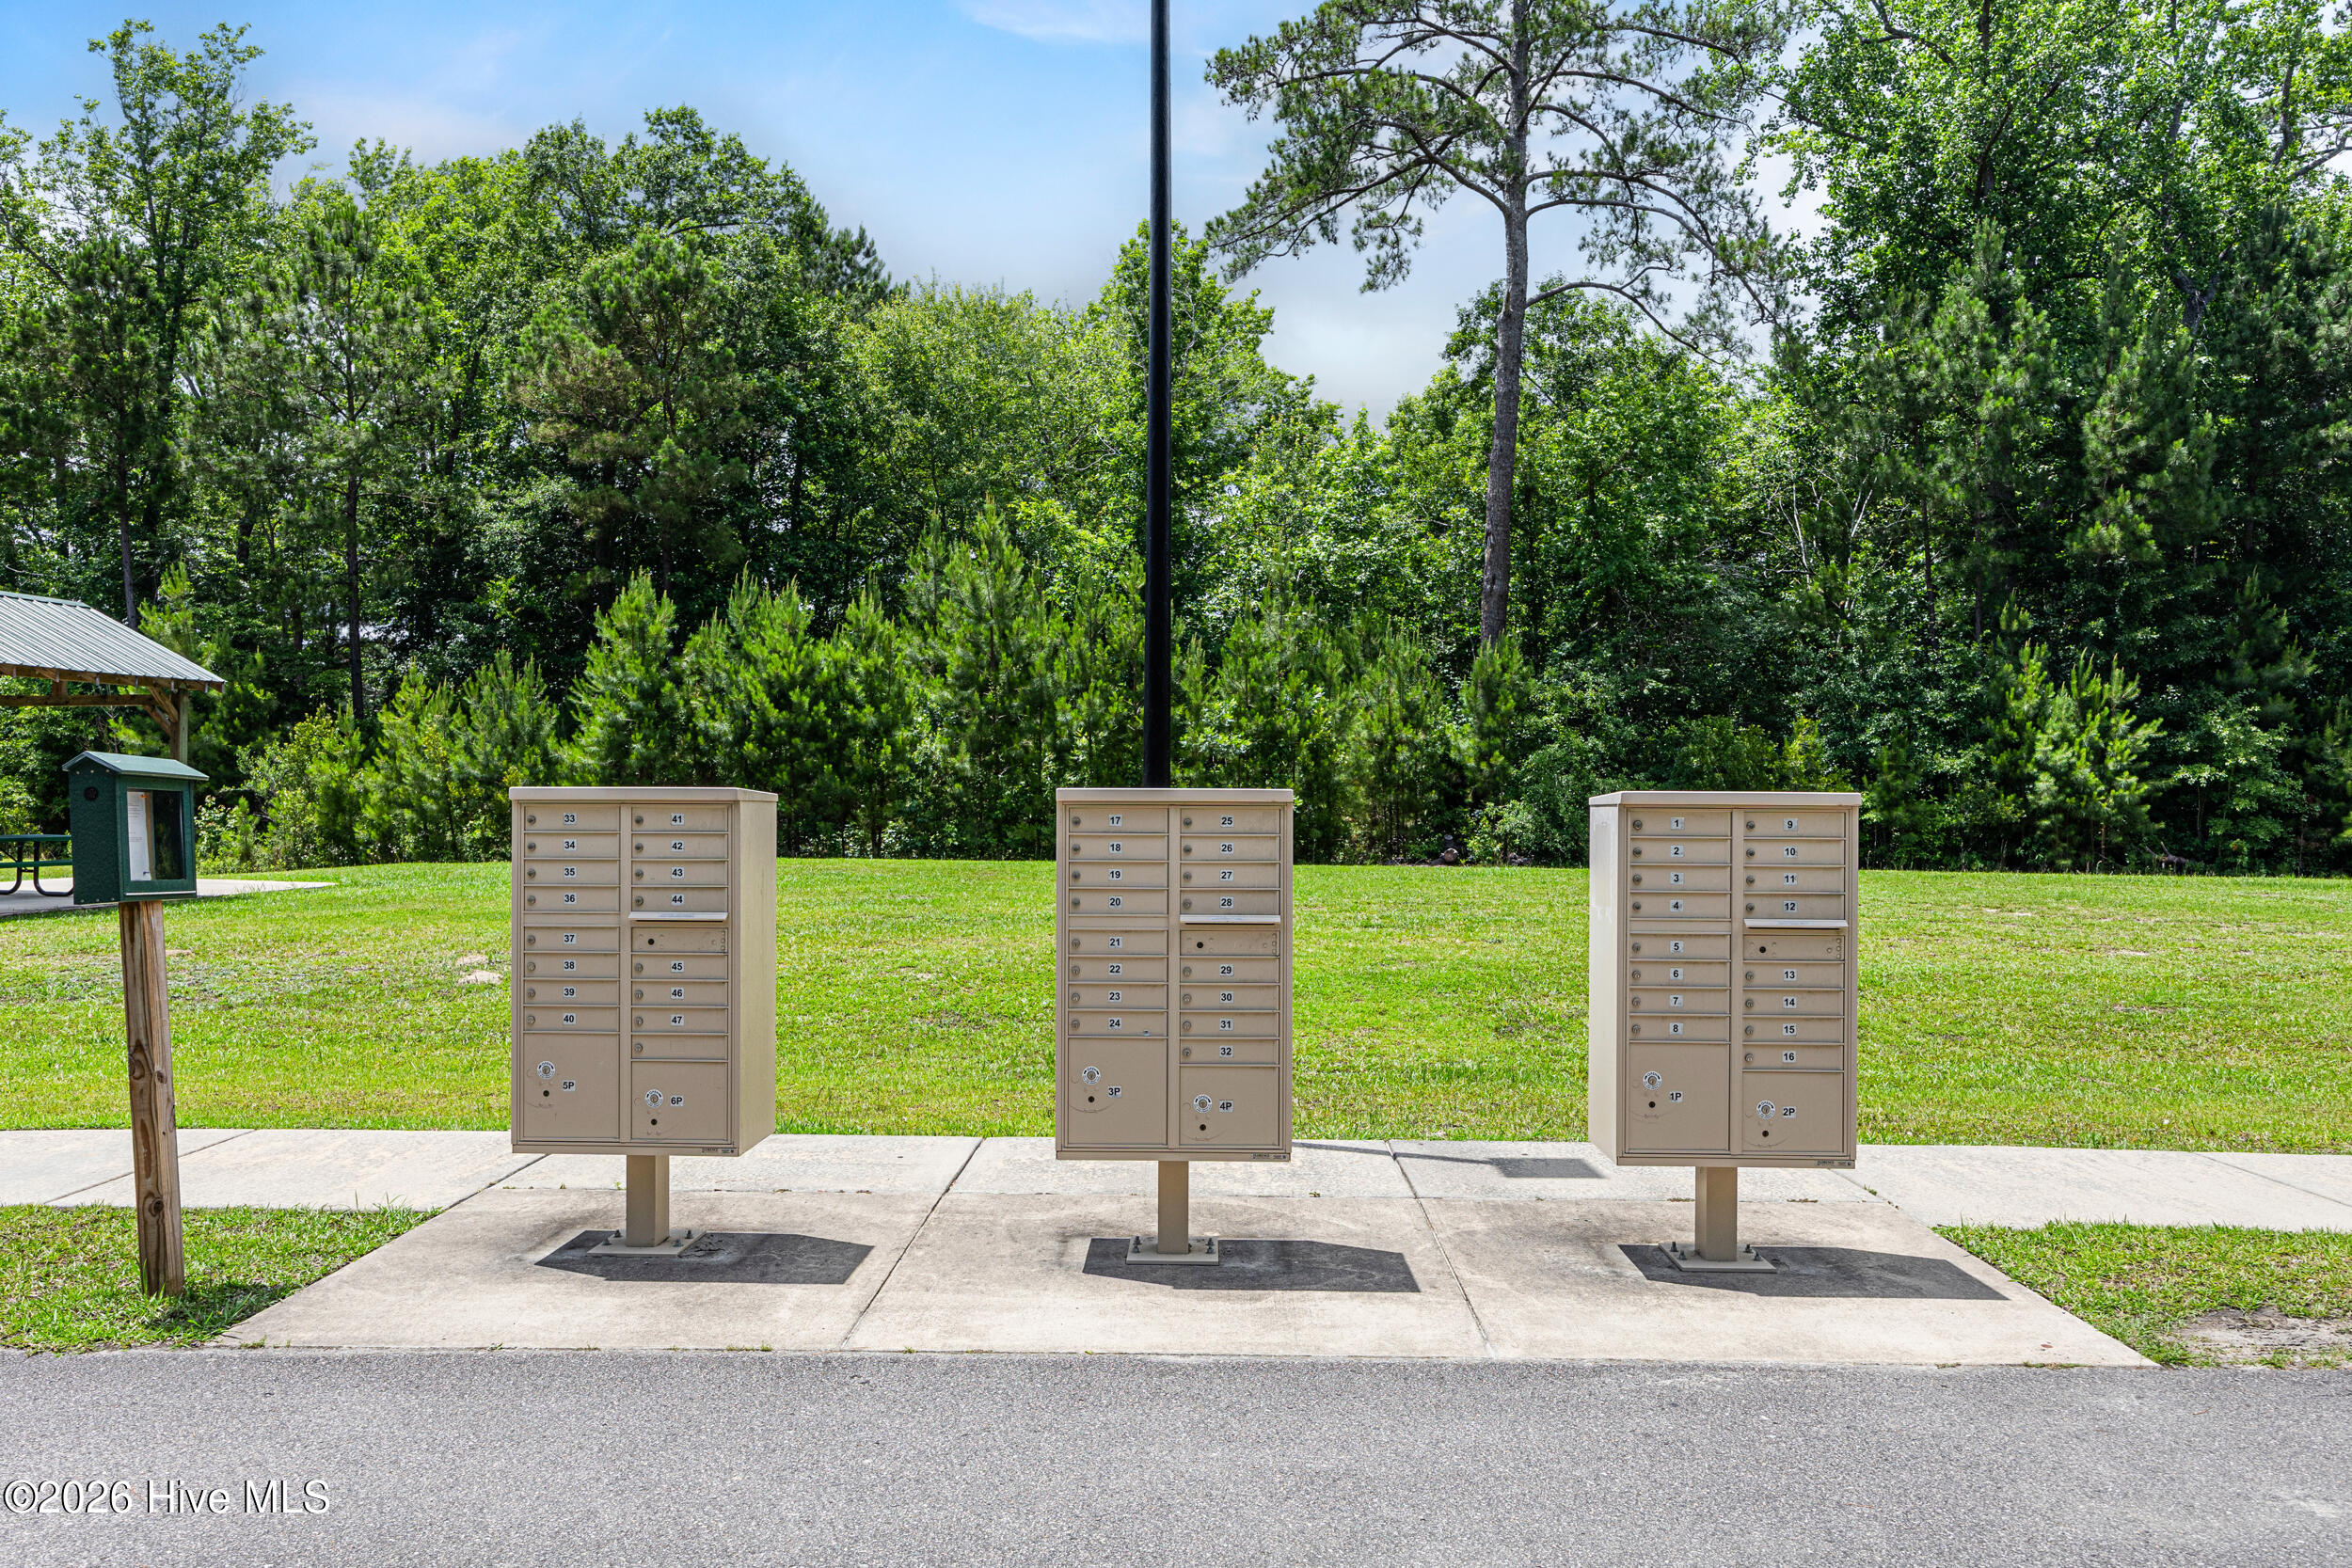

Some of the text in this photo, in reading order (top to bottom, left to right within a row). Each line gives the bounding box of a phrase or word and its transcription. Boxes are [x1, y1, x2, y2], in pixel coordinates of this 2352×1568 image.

[564, 814, 576, 823] 33
[672, 815, 682, 823] 41
[1109, 816, 1121, 825] 17
[1221, 816, 1233, 826] 25
[1674, 819, 1679, 828] 1
[1787, 820, 1793, 829] 9
[564, 841, 576, 849] 34
[671, 842, 683, 850] 42
[1110, 843, 1121, 852] 18
[1221, 844, 1232, 852] 26
[1674, 847, 1679, 855] 2
[1785, 847, 1796, 856] 10
[564, 867, 576, 877] 35
[672, 868, 683, 877] 43
[1109, 870, 1121, 879] 19
[1221, 871, 1232, 879] 27
[1673, 874, 1679, 882] 3
[1784, 875, 1795, 883] 11
[564, 894, 576, 903] 36
[672, 895, 683, 904] 44
[1109, 897, 1121, 907] 20
[1220, 897, 1232, 907] 28
[1673, 901, 1679, 911] 4
[1784, 902, 1796, 911] 12
[564, 934, 575, 942] 37
[1109, 938, 1120, 946] 21
[1674, 942, 1679, 951] 5
[564, 960, 575, 970] 38
[671, 962, 683, 971] 45
[1109, 964, 1120, 974] 22
[1220, 965, 1232, 974] 29
[1673, 969, 1679, 978] 6
[1784, 970, 1795, 979] 13
[564, 988, 575, 996] 39
[671, 989, 683, 998] 46
[1109, 991, 1120, 1001] 23
[1220, 992, 1232, 1002] 30
[1673, 996, 1679, 1006] 7
[1784, 998, 1795, 1006] 14
[563, 1014, 575, 1023] 40
[671, 1016, 683, 1024] 47
[1109, 1019, 1120, 1028] 24
[1220, 1020, 1232, 1029] 31
[1673, 1023, 1679, 1033] 8
[1784, 1025, 1795, 1034] 15
[1220, 1047, 1232, 1056] 32
[1783, 1053, 1795, 1061] 16
[563, 1081, 575, 1090] 5P
[1108, 1087, 1120, 1097] 3P
[1670, 1092, 1682, 1101] 1P
[670, 1097, 683, 1105] 6P
[1219, 1101, 1232, 1111] 4P
[1783, 1107, 1796, 1117] 2P
